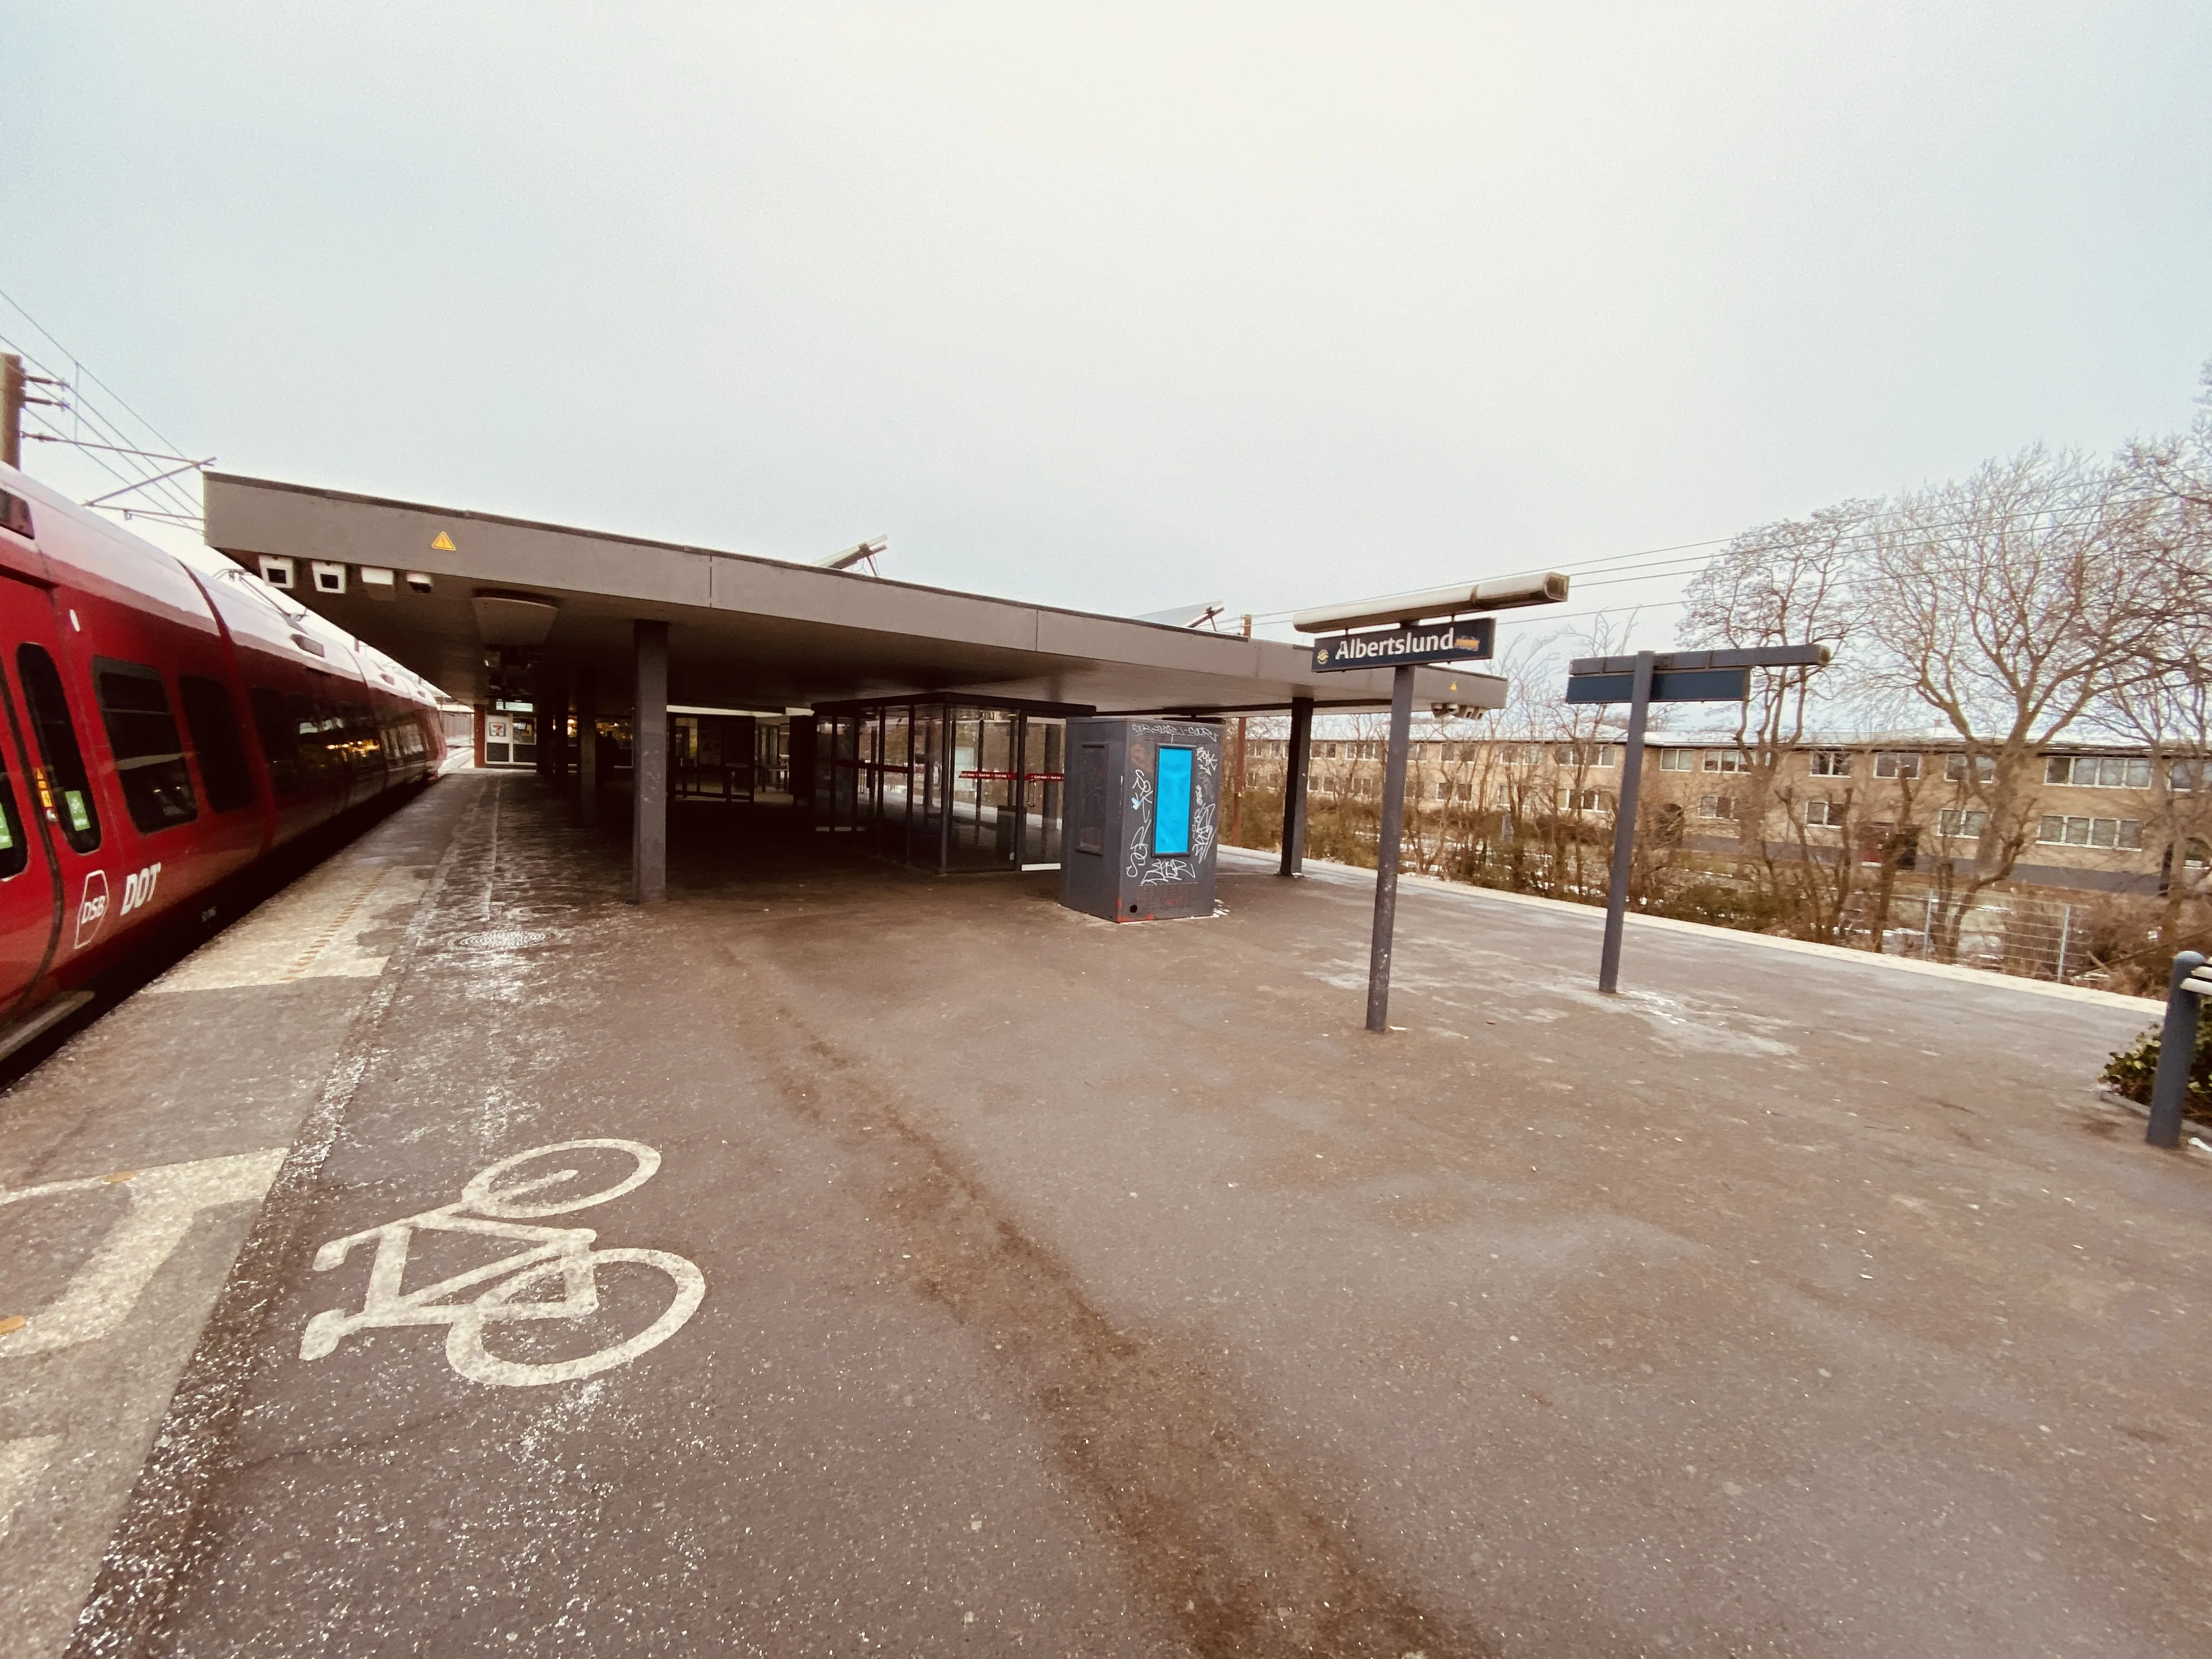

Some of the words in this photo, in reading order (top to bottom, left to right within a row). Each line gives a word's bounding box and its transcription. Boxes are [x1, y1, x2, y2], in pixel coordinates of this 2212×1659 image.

[1335, 627, 1454, 660] Albertslund
[120, 861, 161, 916] DOT
[81, 895, 106, 925] DSB
